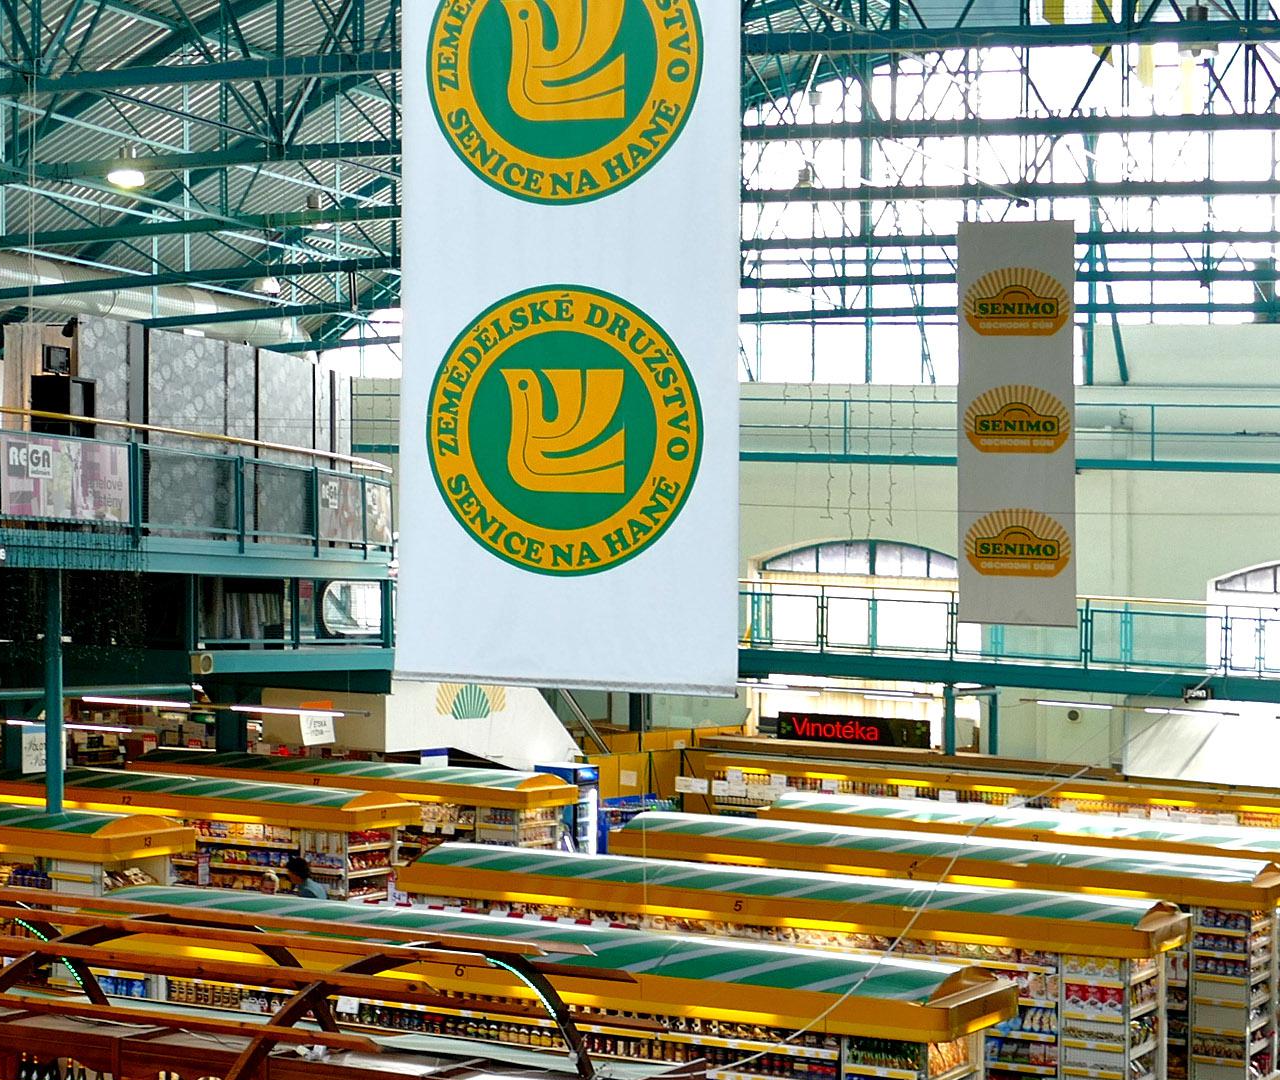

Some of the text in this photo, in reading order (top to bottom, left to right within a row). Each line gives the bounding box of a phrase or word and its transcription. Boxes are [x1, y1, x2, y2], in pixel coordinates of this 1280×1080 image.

[447, 99, 681, 196] SENICE NA HANÉ
[978, 303, 1055, 315] SENIMO
[437, 293, 690, 461] ZEMĚDĚLSKÉ DRUŽSTVO
[979, 420, 1055, 432] SENIMO
[9, 447, 51, 468] REGA
[447, 473, 681, 567] SENICE NA HANÉ
[979, 543, 1056, 556] SENIMO
[792, 716, 879, 741] Vinotéka
[734, 900, 742, 911] 5
[455, 964, 466, 977] 6
